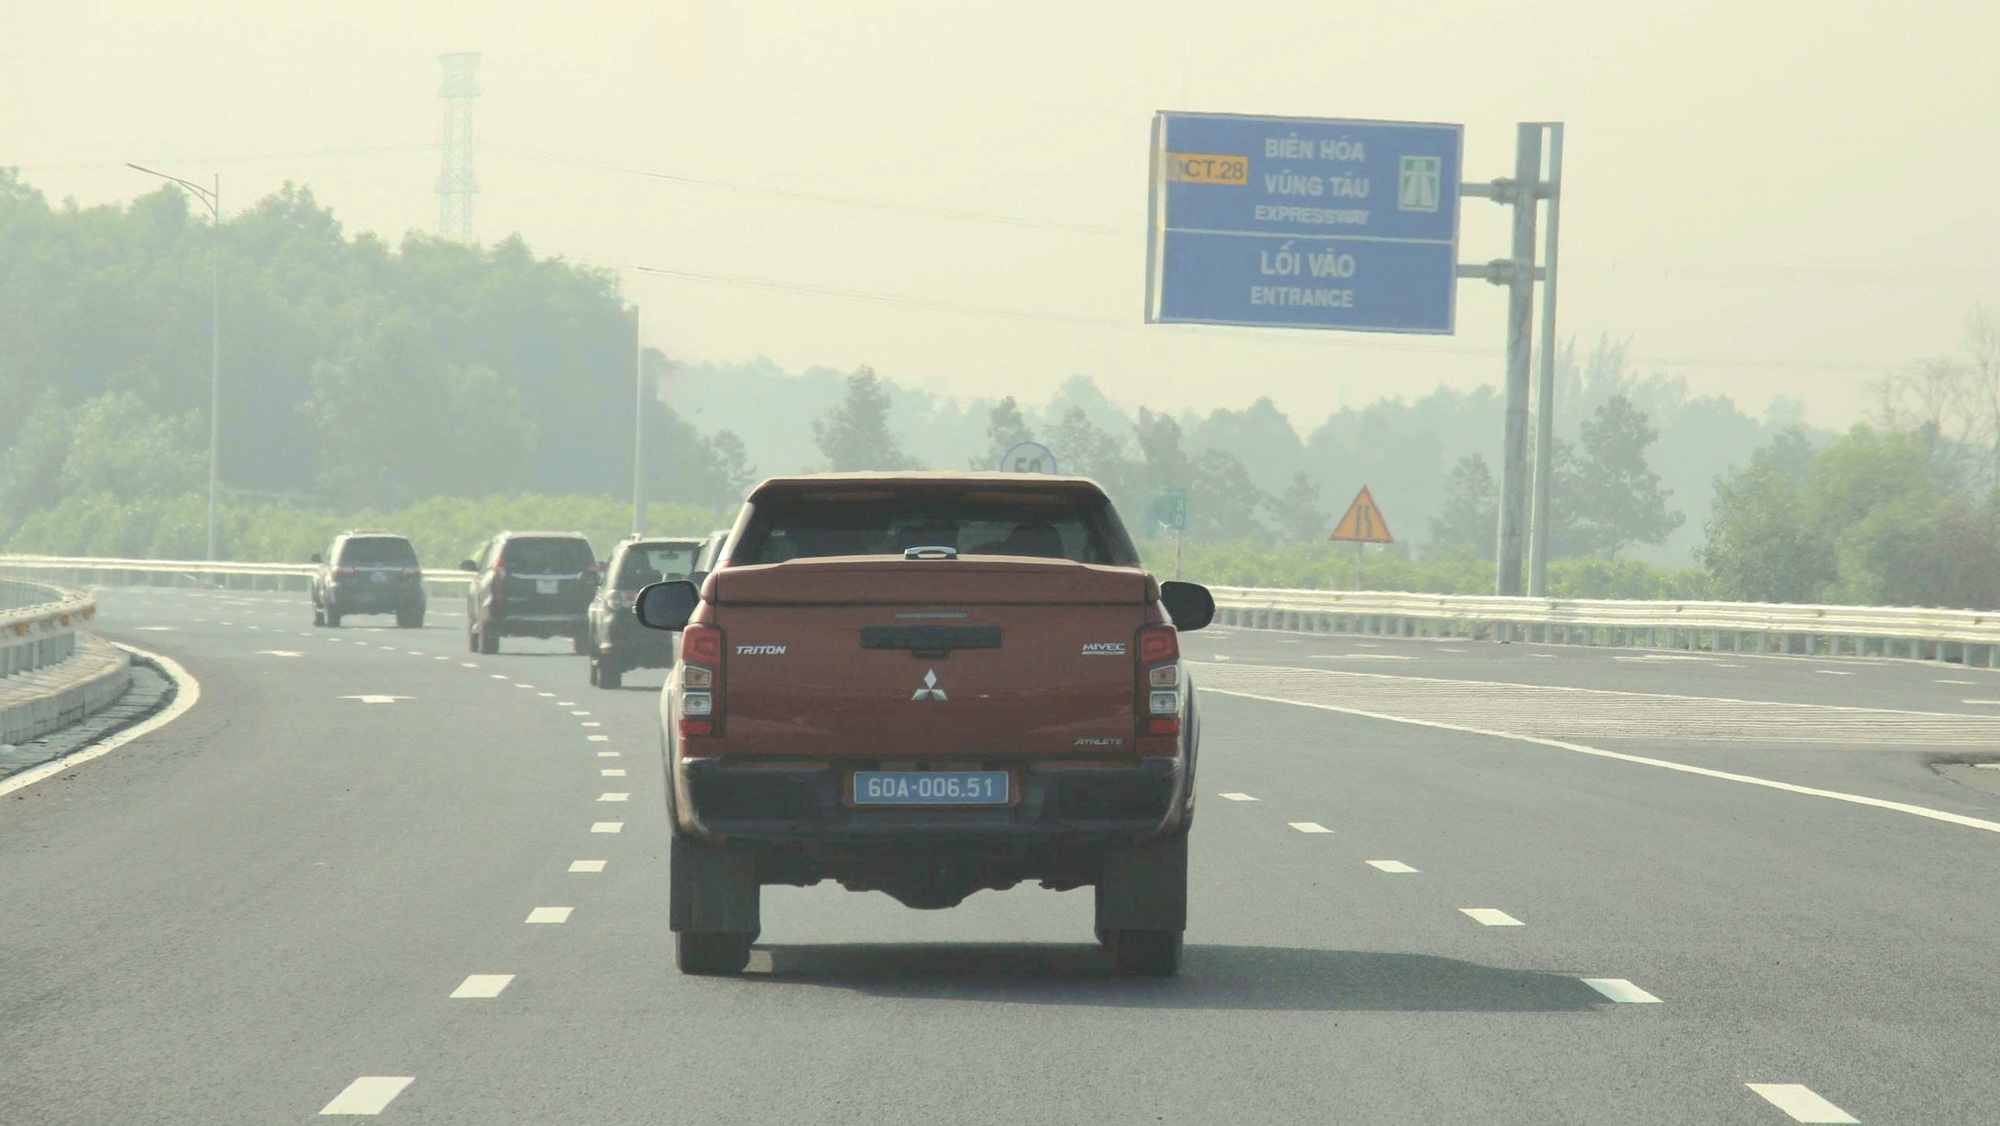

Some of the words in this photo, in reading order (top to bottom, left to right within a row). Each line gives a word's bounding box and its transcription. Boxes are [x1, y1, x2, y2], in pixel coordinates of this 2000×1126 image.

[1265, 131, 1314, 159] BIÊN
[1185, 159, 1244, 180] CT.28
[1254, 205, 1370, 225] EXPRESSWAY
[1260, 239, 1302, 275] LỐI
[1250, 285, 1354, 308] ENTRANCE
[735, 645, 787, 656] TRITON
[1082, 642, 1126, 651] MIVEC
[1074, 737, 1124, 746] ATHLETE
[868, 777, 993, 798] 60A-006.51
